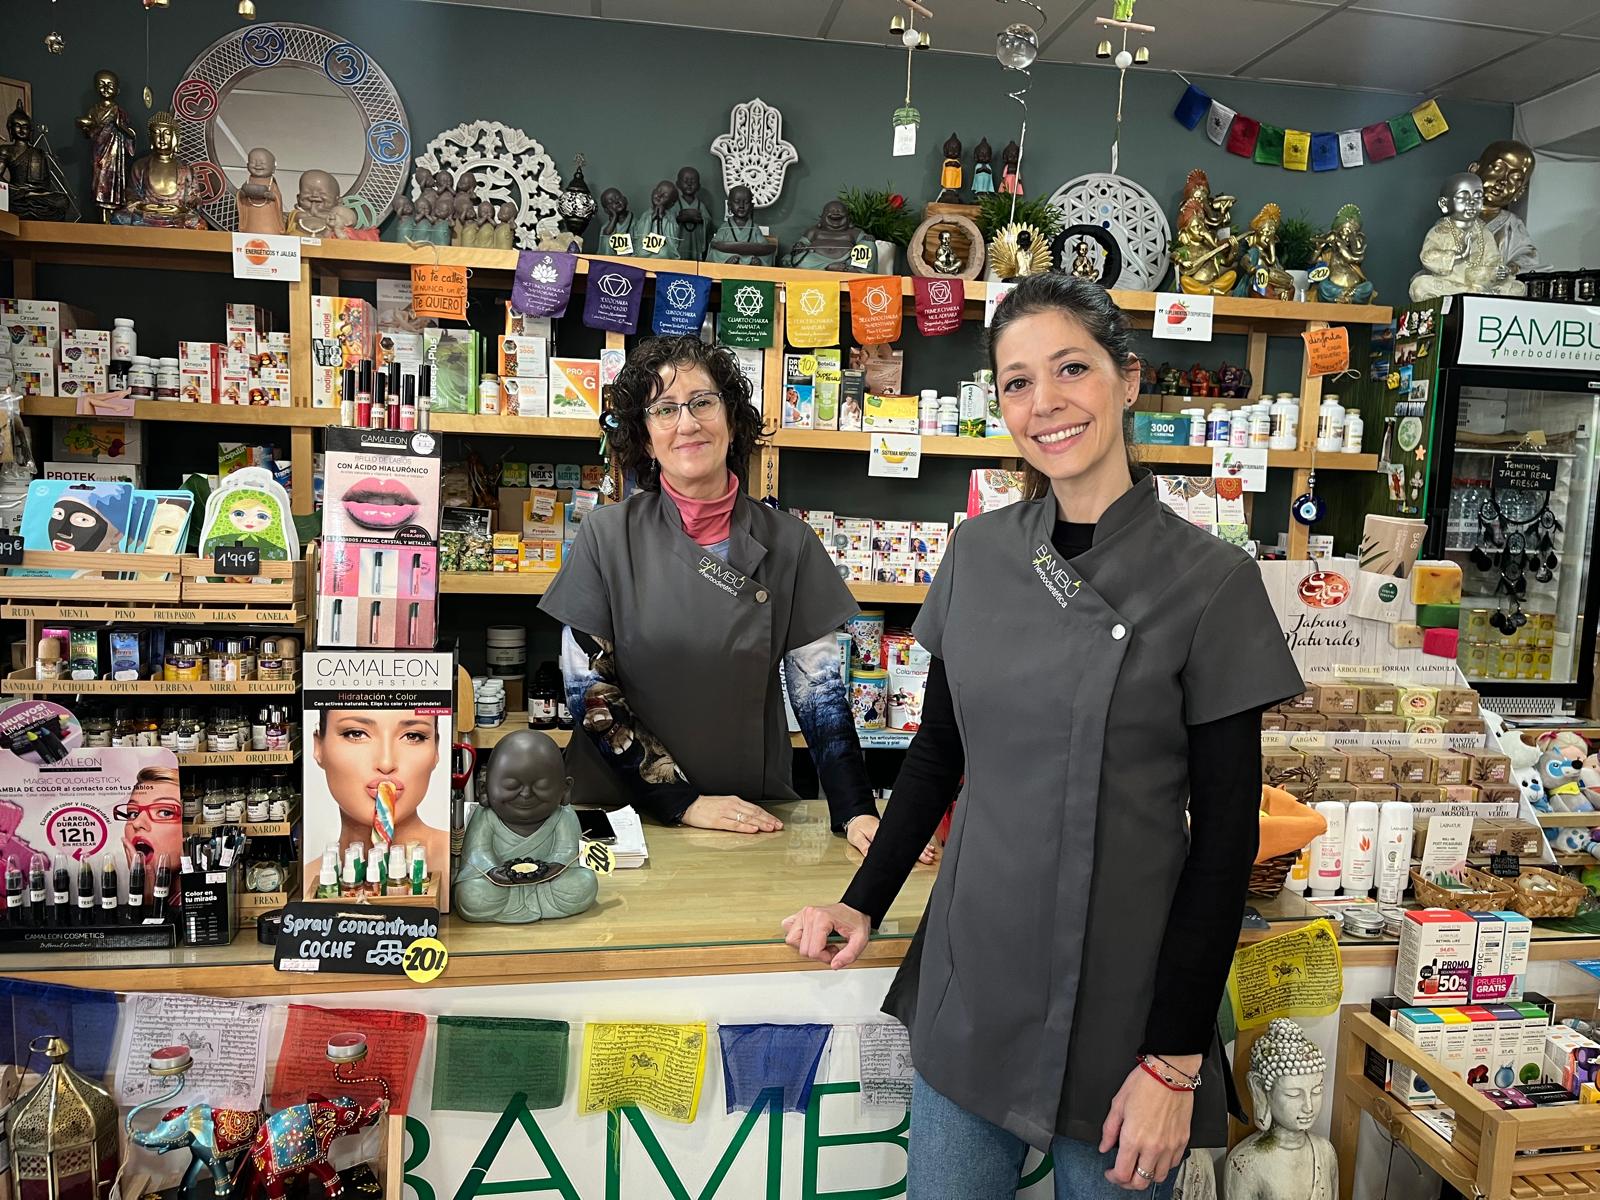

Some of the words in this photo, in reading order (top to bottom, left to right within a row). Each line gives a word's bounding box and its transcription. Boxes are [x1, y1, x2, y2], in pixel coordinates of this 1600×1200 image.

[414, 269, 426, 281] No
[430, 269, 438, 281] te
[441, 271, 464, 284] calles
[426, 296, 460, 310] QUIERO
[1503, 347, 1600, 361] herbodietétic
[583, 376, 596, 390] G
[1150, 423, 1175, 433] 3000
[360, 434, 408, 445] CAMALEON
[337, 462, 353, 470] CON
[354, 460, 377, 471] ÁCIDO
[378, 465, 429, 475] HIALURÓNICO
[46, 471, 96, 482] PROTEK
[1499, 470, 1526, 478] JALEA
[1530, 472, 1552, 480] REAL
[1510, 479, 1540, 488] FRESCA
[698, 556, 746, 590] BAMBÚ
[1035, 543, 1082, 598] BAMBÚ
[1032, 562, 1068, 608] herbodietética
[11, 607, 35, 618] RUDA
[59, 608, 90, 619] MENTA
[114, 609, 136, 619] PINO
[153, 611, 173, 620] FRUTA
[212, 611, 237, 621] LILAS
[256, 611, 289, 621] CANELA
[1287, 613, 1347, 633] Jabones
[1284, 629, 1361, 652] Naturales
[316, 658, 439, 678] CAMALEON
[1416, 665, 1456, 673] CALÉNDULA
[52, 682, 96, 692] PACHOULI
[110, 682, 139, 692] OPIUM
[154, 682, 194, 692] VERBENA
[209, 682, 238, 692] MIRRA
[248, 682, 295, 692] EUCALIPTO
[316, 679, 439, 687] COLOURSTICK
[338, 692, 386, 701] Hidratación
[395, 692, 417, 701] Color
[0, 702, 48, 730] ¡NUEVOS!
[2, 721, 23, 737] LIMA
[32, 708, 56, 724] AZUL
[40, 757, 103, 767] AMALEON
[203, 754, 235, 764] JAZMIN
[245, 753, 289, 763] ORQUIDEA
[55, 776, 121, 785] COLOURSTICK
[252, 825, 281, 834] NARDO
[59, 828, 95, 843] 12h
[185, 890, 202, 898] Color
[193, 895, 218, 903] mirada
[254, 896, 280, 905] FRESA
[283, 914, 333, 939] Spray
[338, 915, 438, 938] concentrado
[64, 932, 105, 940] COSMETICS
[299, 940, 356, 959] COCHE
[1441, 960, 1469, 969] PROMO
[1476, 977, 1507, 986] PRUEBA
[1476, 984, 1507, 993] GRATIS
[402, 1081, 910, 1200] AMB
